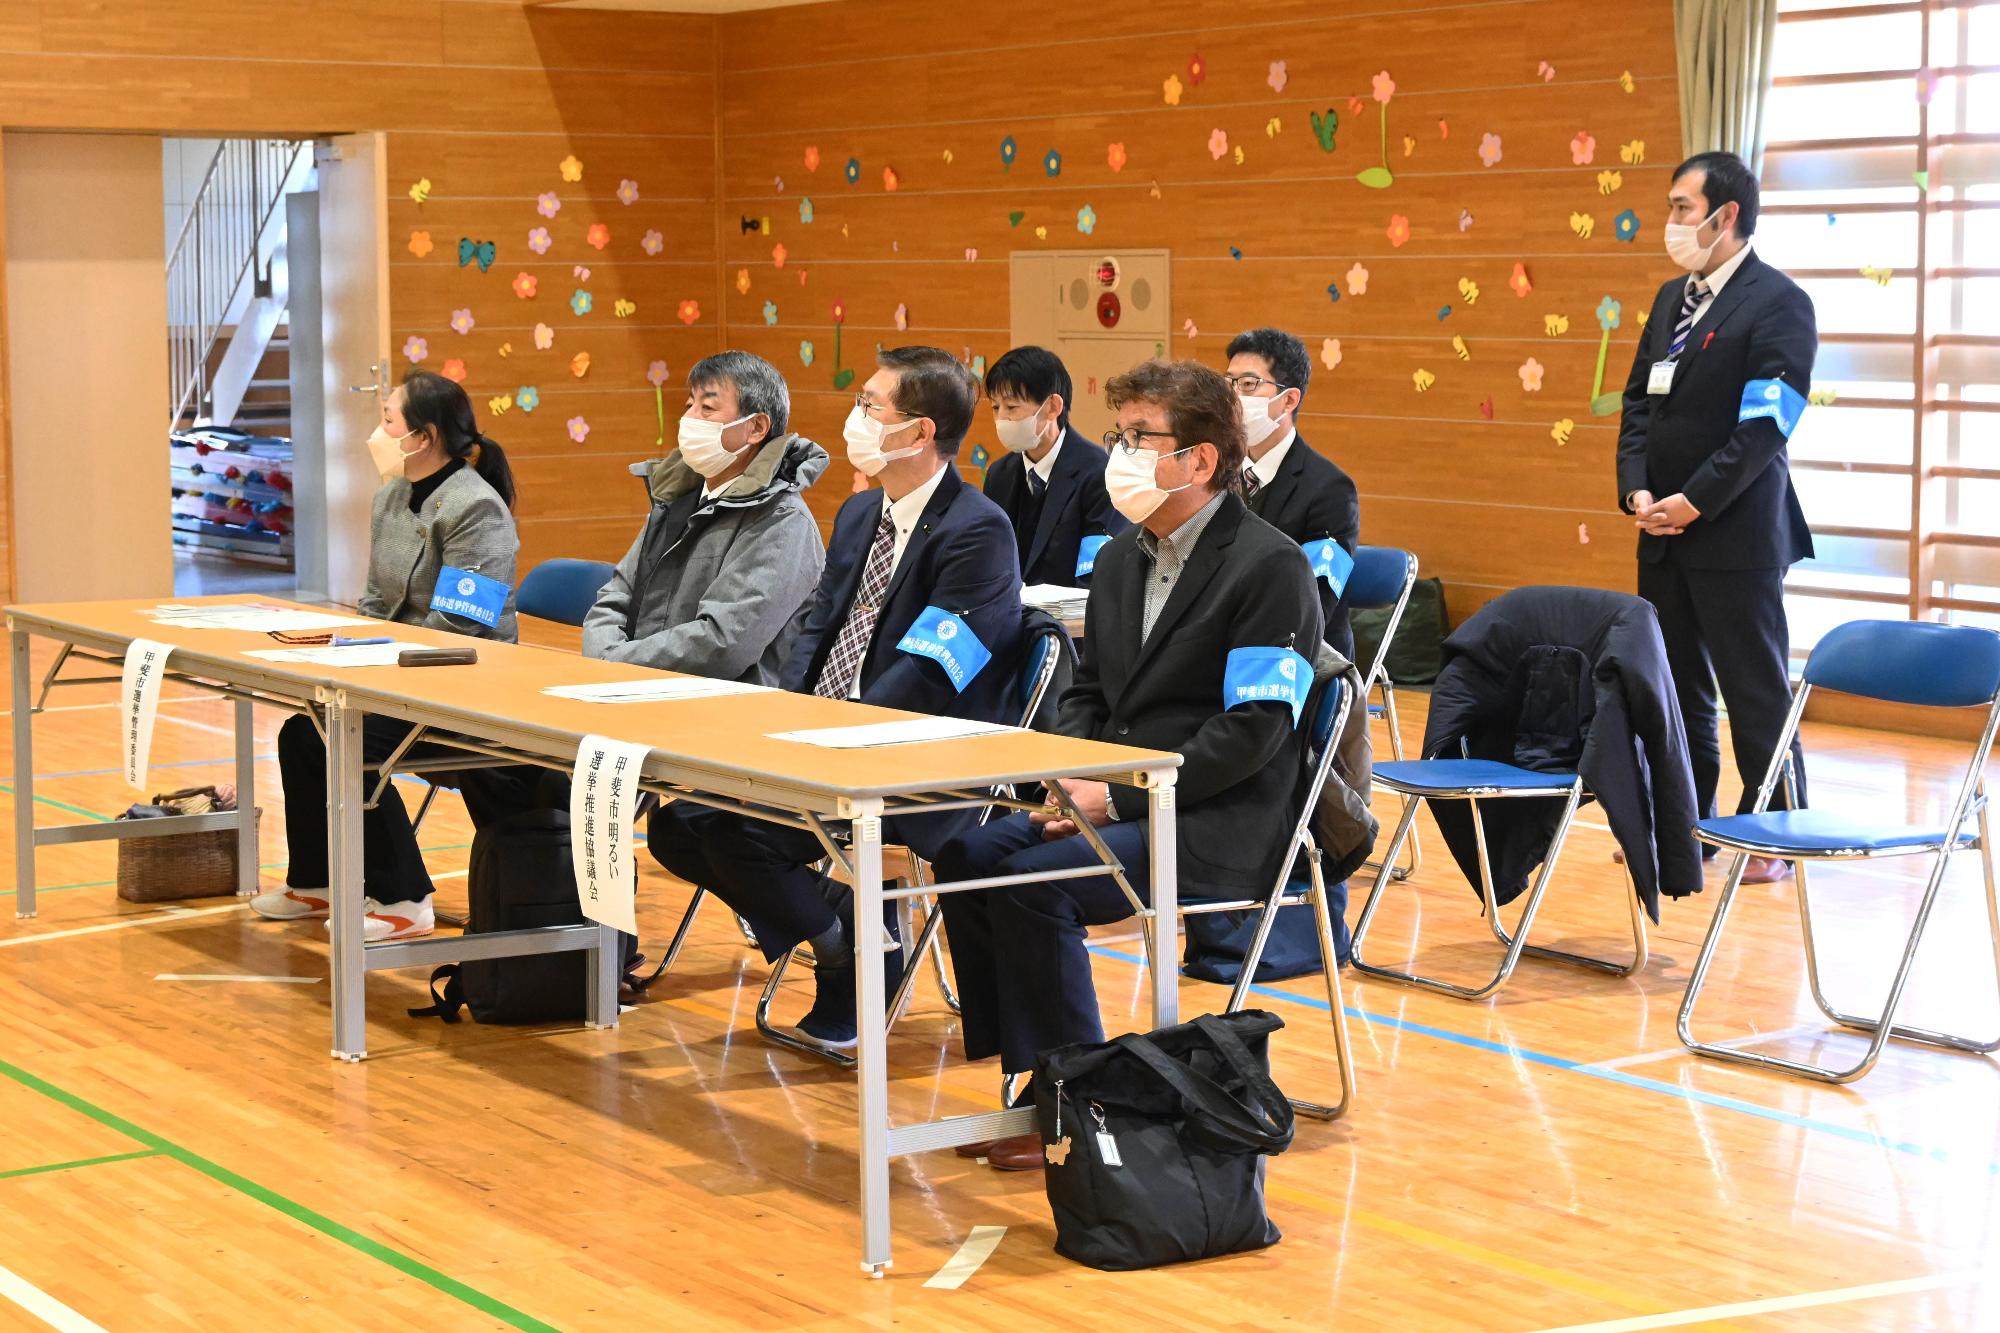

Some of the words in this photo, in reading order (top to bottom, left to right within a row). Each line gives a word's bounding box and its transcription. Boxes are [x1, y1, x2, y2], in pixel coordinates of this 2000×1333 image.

[584, 750, 605, 902] 選挙推進協議会
[608, 756, 628, 880] 甲斐市明るい
